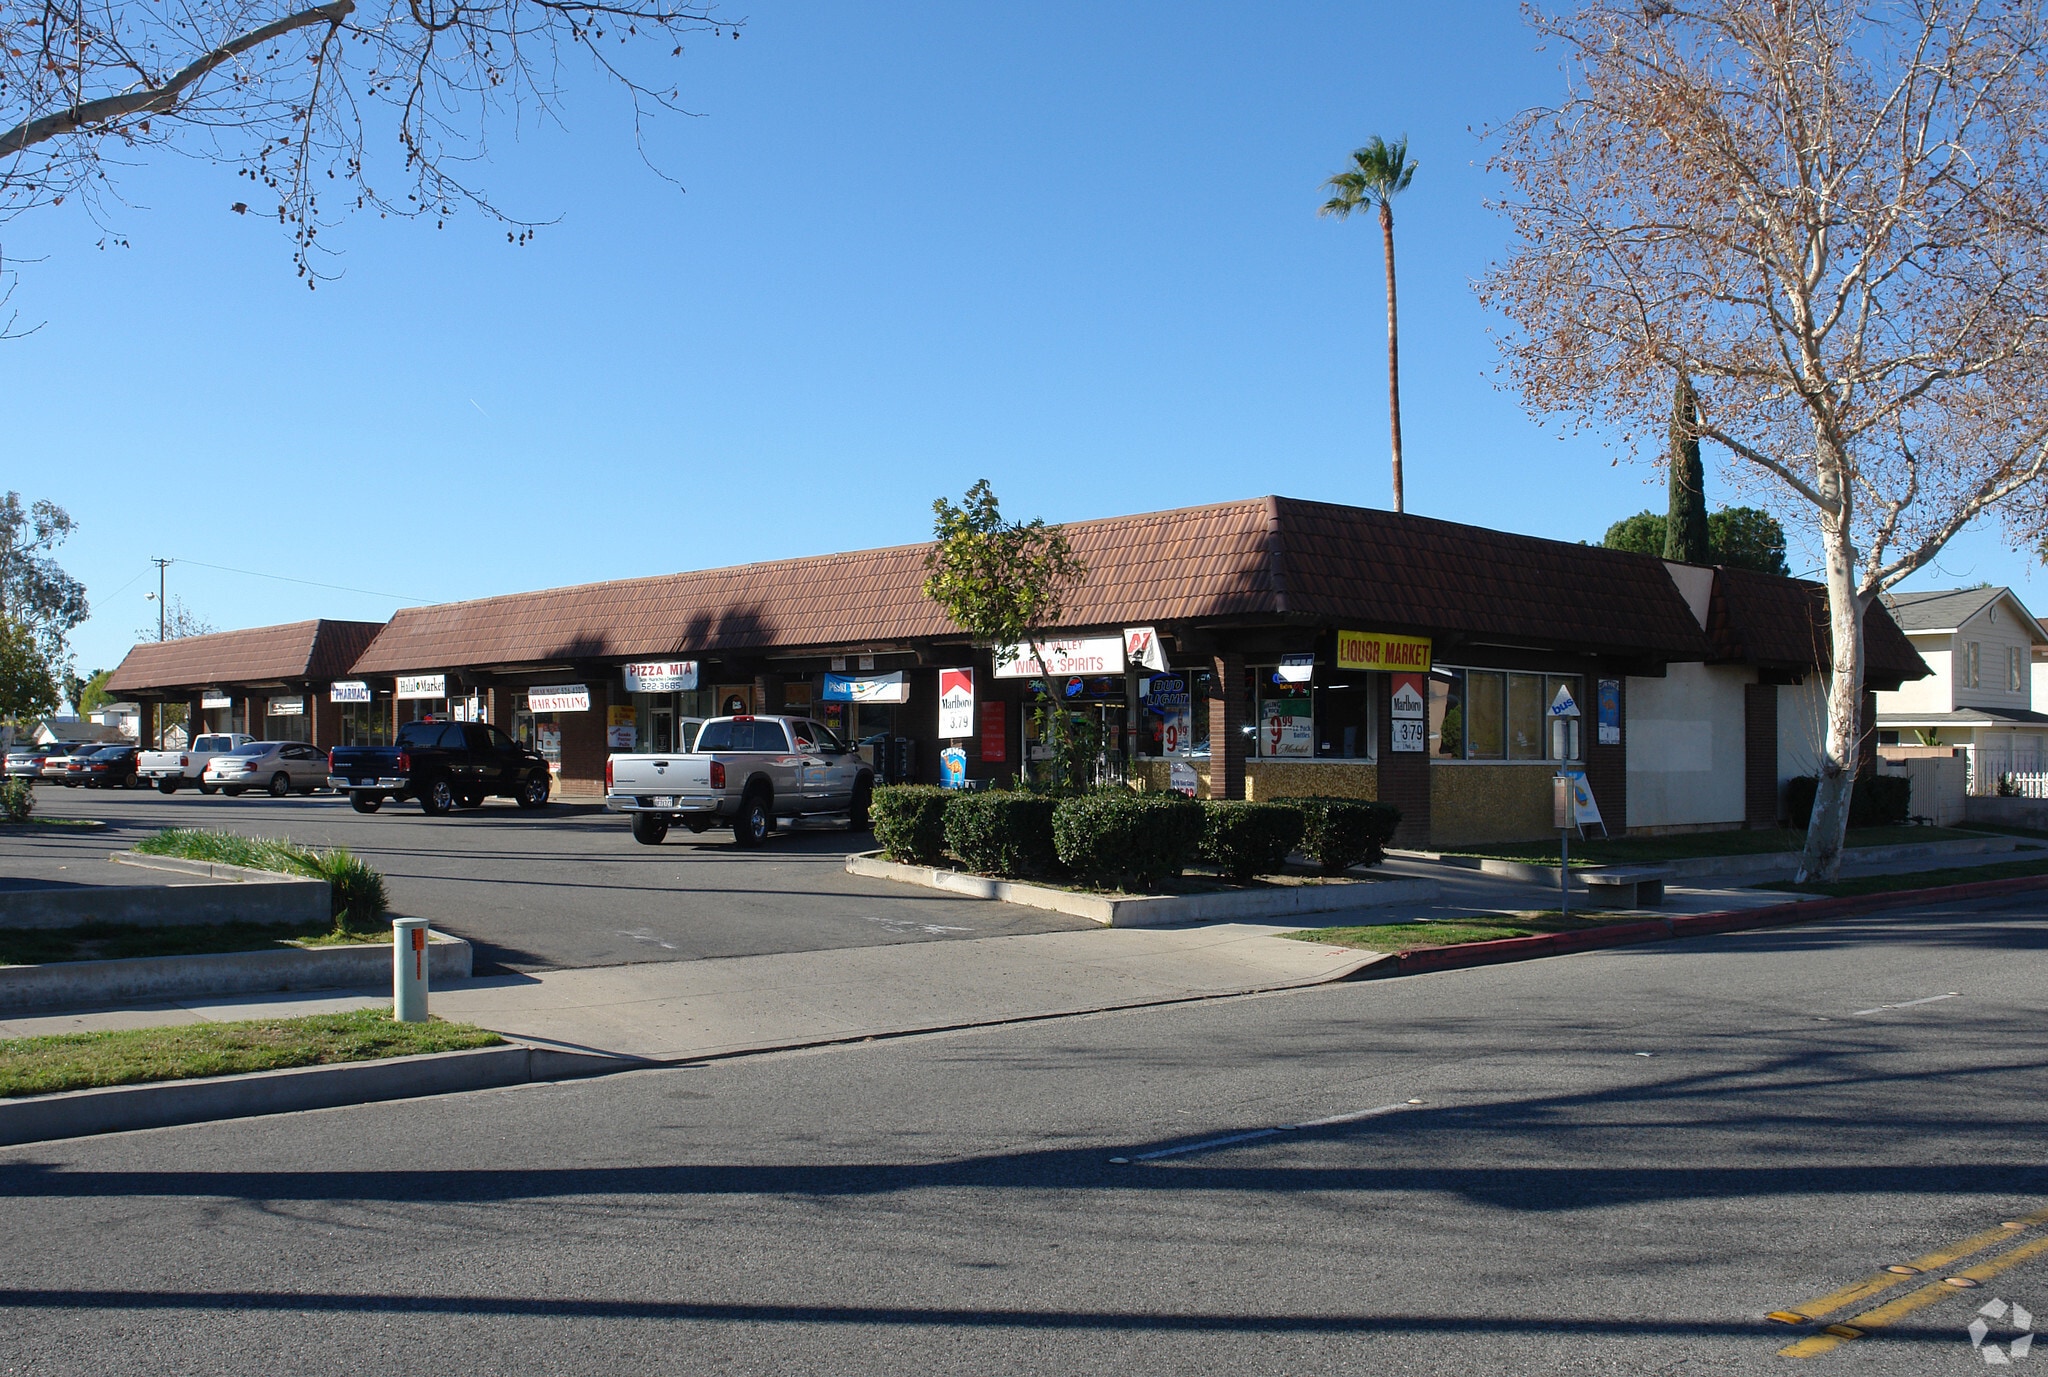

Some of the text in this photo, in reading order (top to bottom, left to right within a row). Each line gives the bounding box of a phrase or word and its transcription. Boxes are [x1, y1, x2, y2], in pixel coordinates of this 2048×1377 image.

[1051, 640, 1082, 651] VALLEY
[1340, 638, 1429, 666] LIQUOR MARKET
[629, 661, 692, 677] PIZZA MIA
[1014, 656, 1104, 674] WINE & SPIRITS
[399, 678, 445, 692] Halal Market
[641, 681, 681, 690] 522-3685
[1153, 680, 1183, 692] BUD
[335, 688, 370, 700] PHARMACY
[1146, 693, 1189, 706] LIGHT
[531, 698, 551, 710] HAIR
[552, 696, 587, 709] STYLING
[942, 694, 972, 710] Marlboro
[1394, 694, 1422, 712] Marlboro
[1552, 698, 1573, 714] bus
[940, 747, 967, 760] CAMEL
